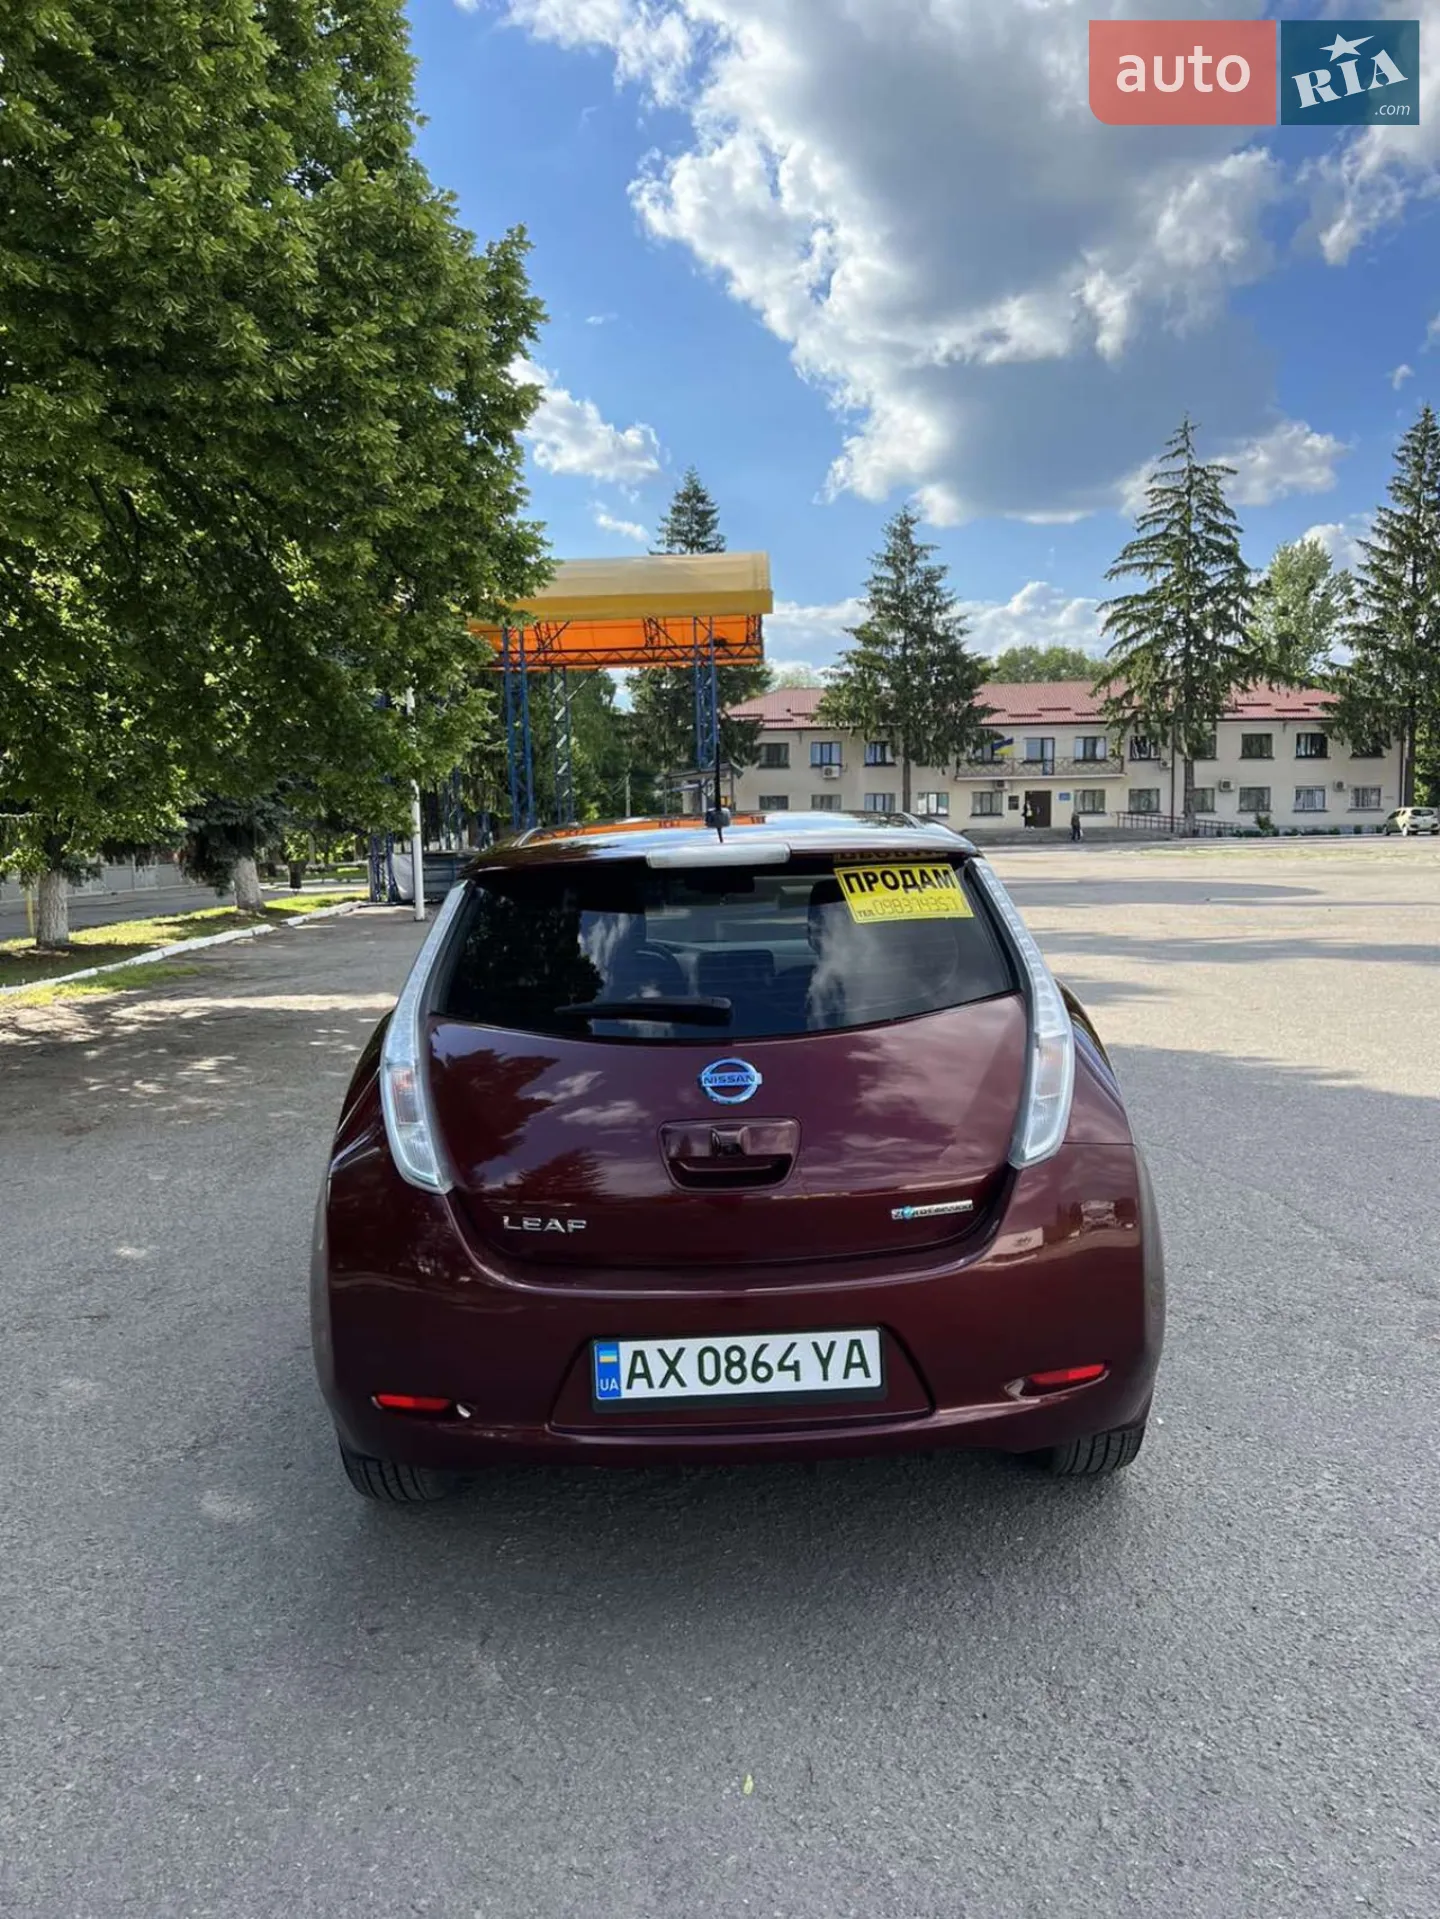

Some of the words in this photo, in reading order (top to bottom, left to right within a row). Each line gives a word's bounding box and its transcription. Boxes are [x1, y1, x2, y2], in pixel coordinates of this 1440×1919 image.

[842, 868, 957, 894] ПРОДАМ
[703, 1074, 756, 1085] NISSAN
[502, 1215, 587, 1233] LEAF
[626, 1347, 688, 1390] AX
[697, 1342, 801, 1386] 0864
[811, 1338, 872, 1381] YA
[600, 1377, 620, 1391] UA
